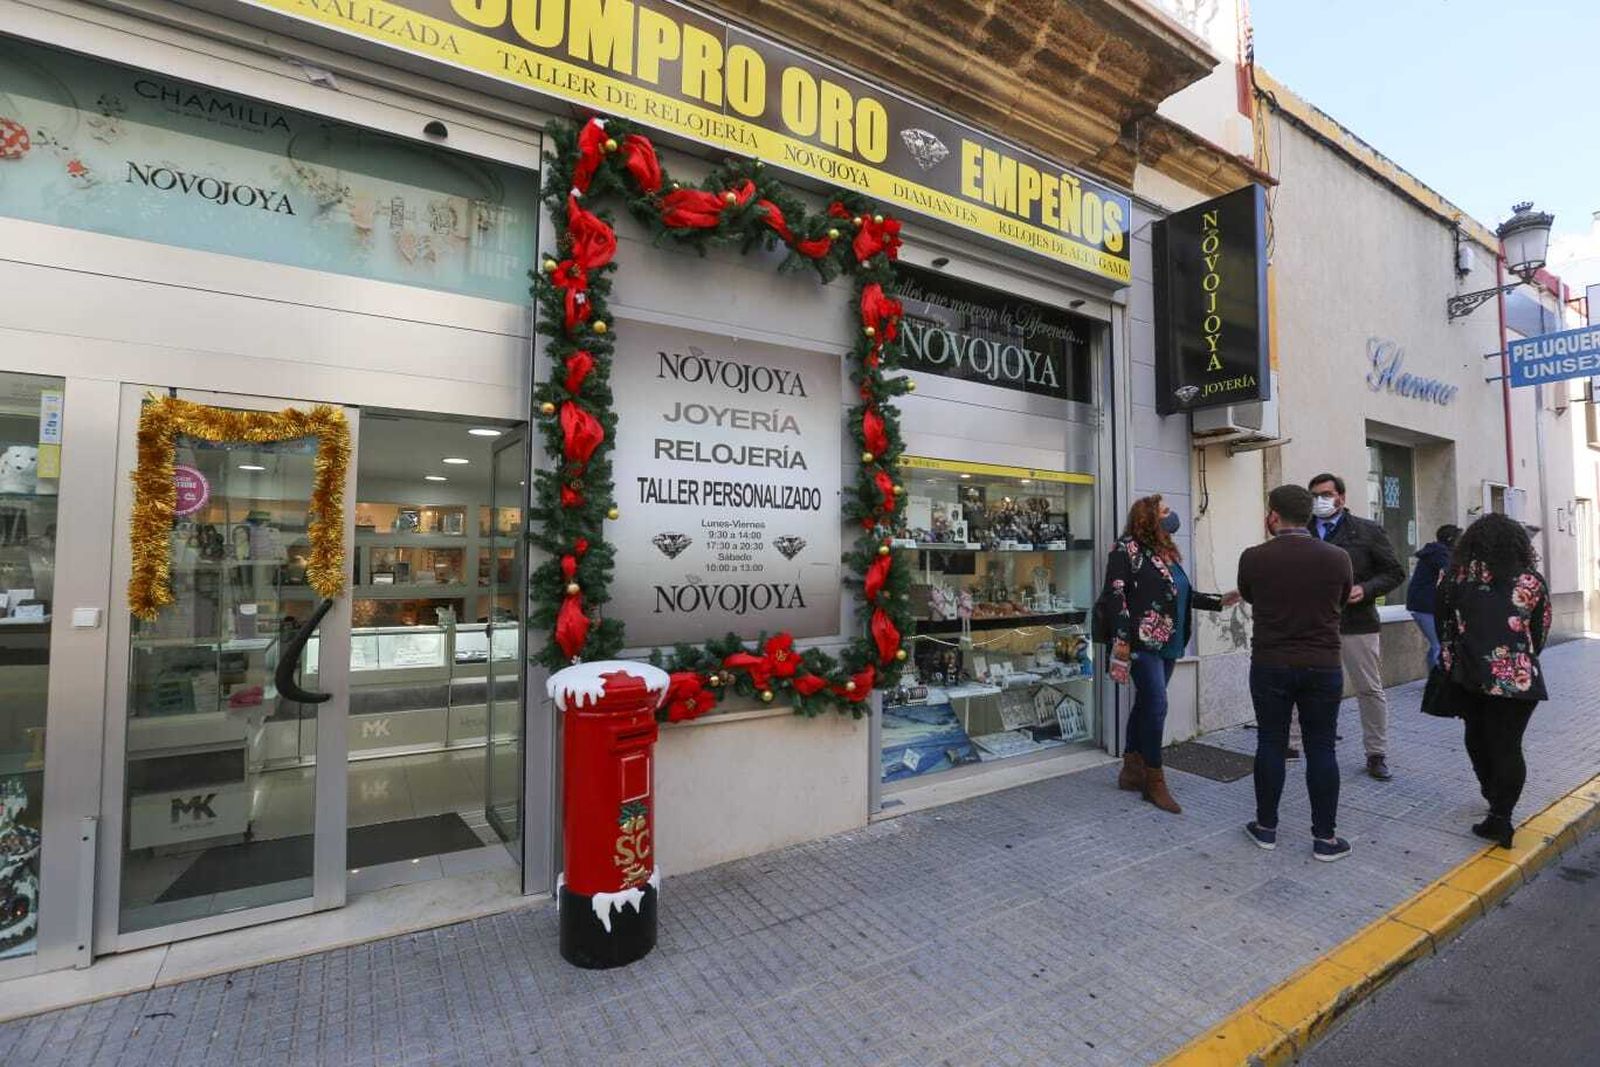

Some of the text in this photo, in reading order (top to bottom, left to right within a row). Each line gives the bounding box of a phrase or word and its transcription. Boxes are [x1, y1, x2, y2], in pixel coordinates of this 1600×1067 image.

[298, 0, 460, 54] ALIZADA
[133, 80, 291, 133] CHAMILIA
[497, 50, 759, 149] TALLER DE RELOJERÍA
[781, 66, 889, 164] ORO
[961, 138, 1124, 253] EMPEÑOS
[125, 160, 297, 216] NOVOJOYA
[784, 143, 870, 188] NOVOJOYA
[892, 182, 979, 224] DIAMANTES
[999, 219, 1050, 248] RELOJES
[1052, 241, 1068, 256] DE
[1099, 254, 1129, 278] GAMA
[1202, 209, 1224, 373] NOVOJOYA
[901, 321, 1060, 388] NOVOJOYA
[656, 352, 808, 398] NOVOJOYA
[1201, 374, 1257, 398] JOYERÍA
[663, 402, 801, 435] JOYERÍA
[654, 438, 808, 470] RELOJERÍA
[637, 477, 822, 511] TALLER PERSONALIZADO
[701, 519, 766, 529] Lunes-Viernes
[708, 530, 728, 539] 9:30
[739, 531, 762, 540] 14:00
[706, 541, 731, 550] 17:30
[740, 542, 764, 551] 20:30
[706, 563, 730, 572] 10:00
[653, 583, 807, 615] NOVOJOYA
[361, 719, 390, 739] MK
[171, 793, 218, 824] MK
